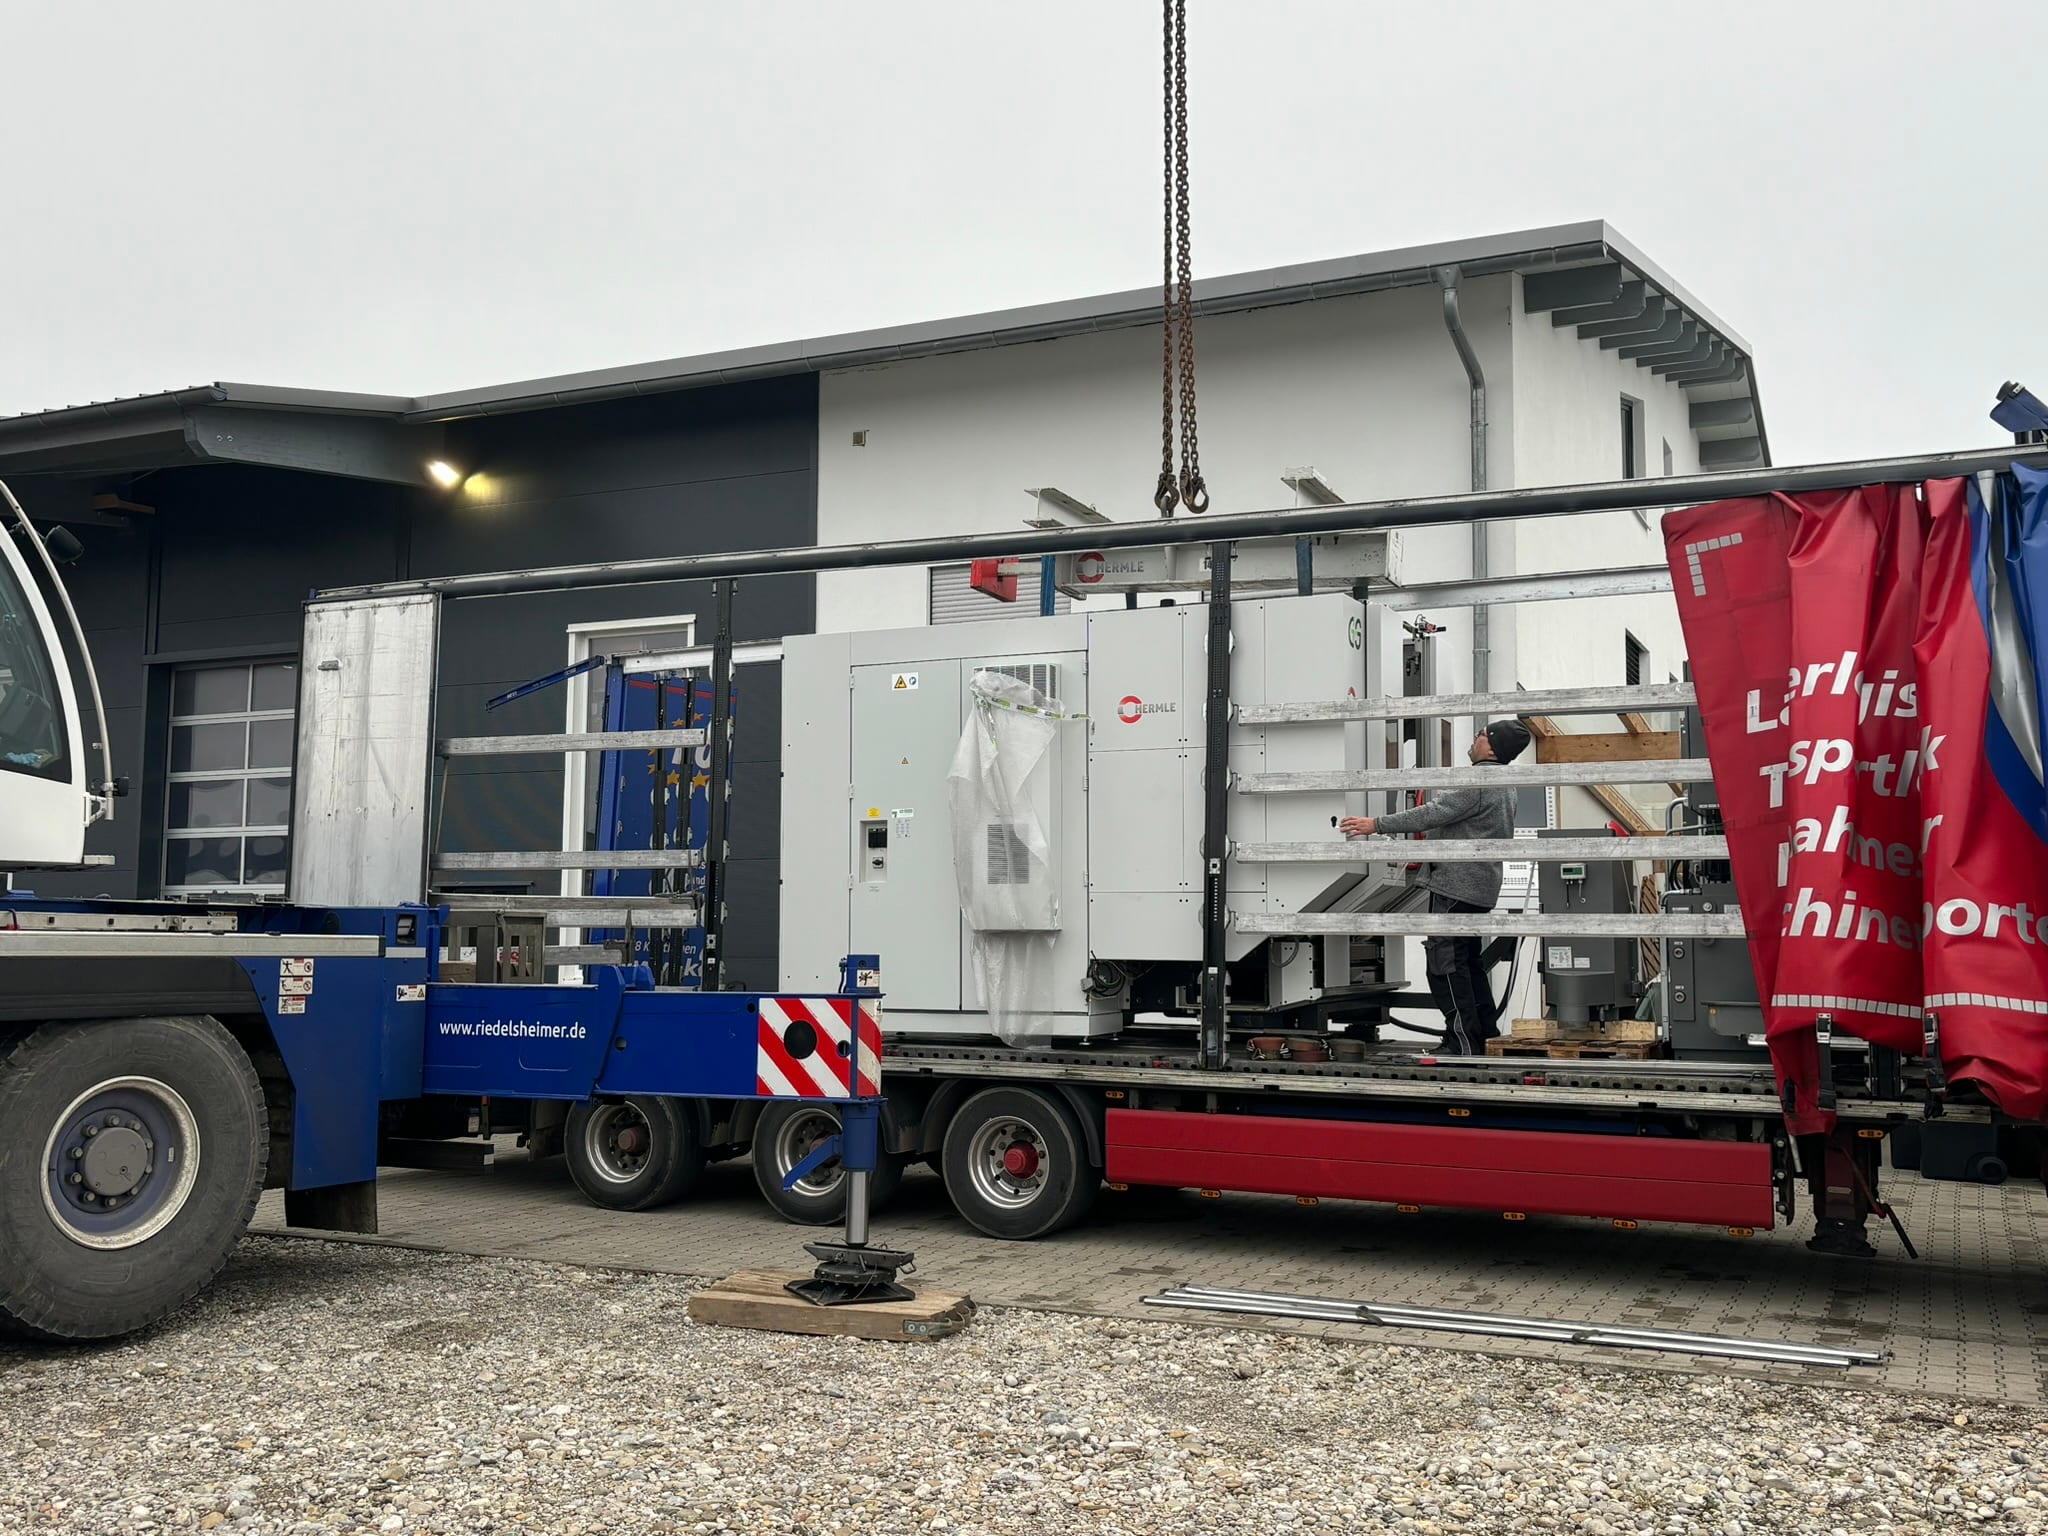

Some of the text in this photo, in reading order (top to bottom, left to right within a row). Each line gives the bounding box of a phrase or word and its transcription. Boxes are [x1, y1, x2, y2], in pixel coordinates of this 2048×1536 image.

[1096, 561, 1145, 573] HERMLE
[1134, 702, 1177, 714] HERMLE
[439, 1020, 587, 1039] www.riedelsheimer.de
